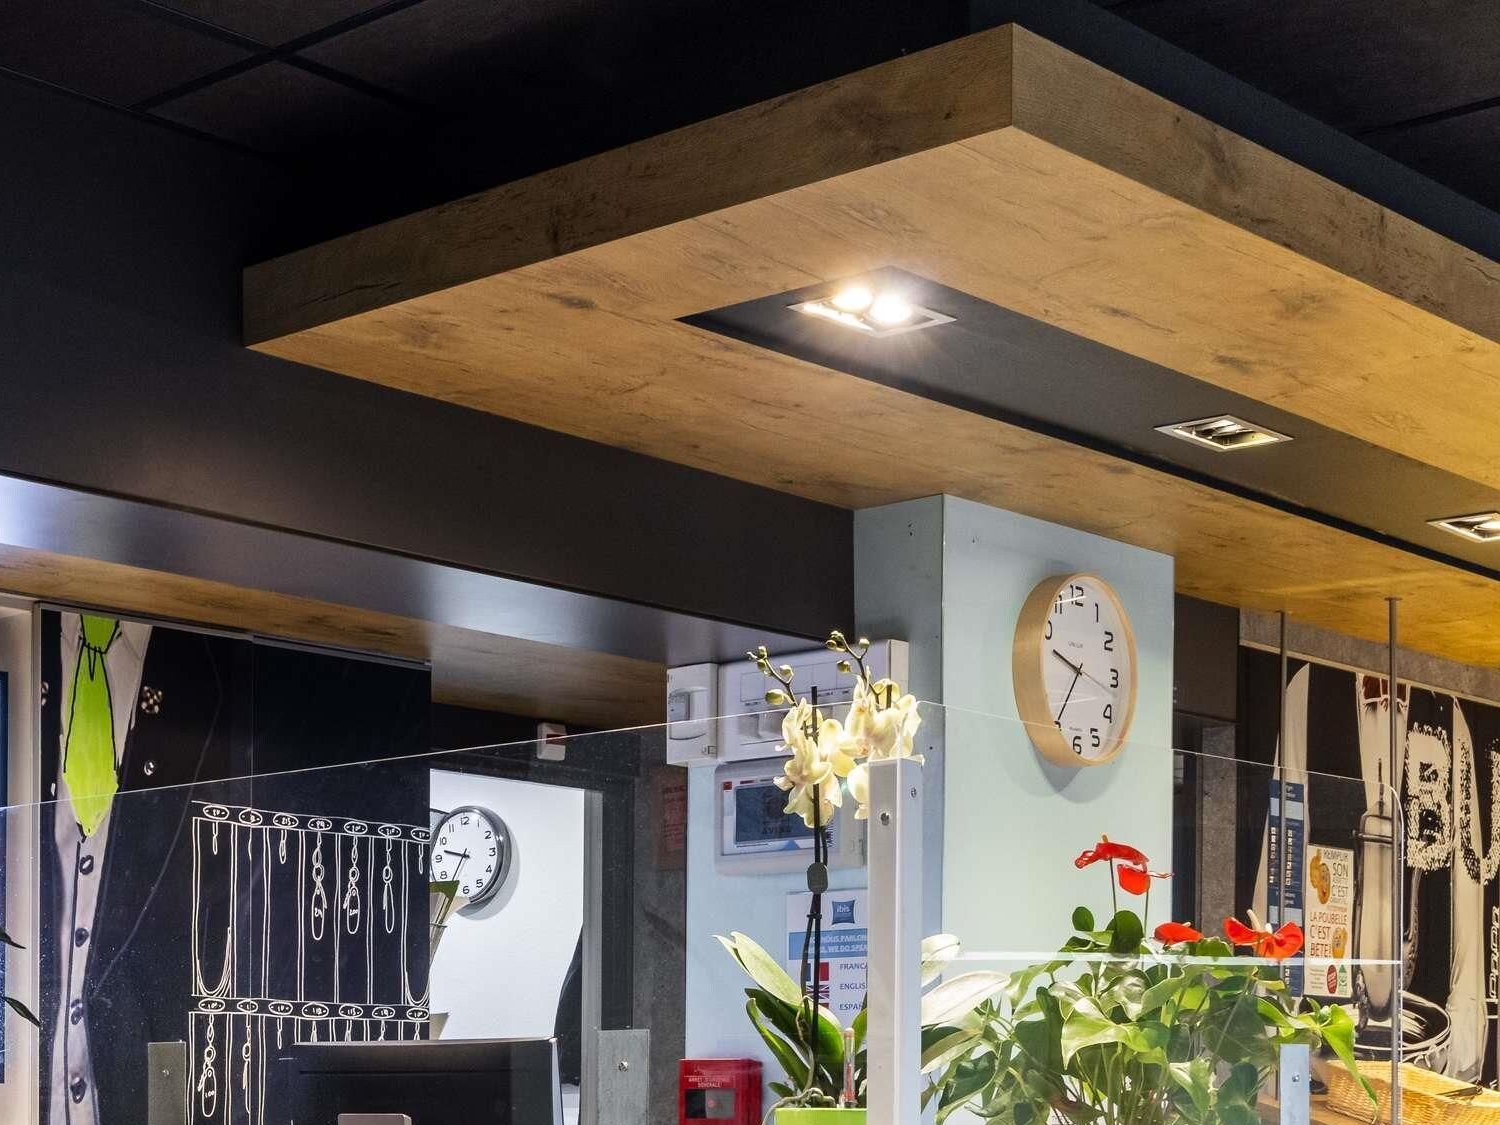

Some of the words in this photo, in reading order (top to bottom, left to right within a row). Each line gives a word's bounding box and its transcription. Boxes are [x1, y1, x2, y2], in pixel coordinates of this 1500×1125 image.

[1069, 584, 1084, 608] 12
[1103, 631, 1114, 652] 2
[1109, 668, 1120, 689] 3
[1102, 703, 1113, 724] 4
[1090, 728, 1101, 748] 5
[1072, 736, 1082, 755] 6
[460, 816, 471, 826] 12
[439, 837, 447, 847] 10
[488, 847, 496, 857] 3
[435, 854, 443, 863] 9
[439, 870, 448, 880] 8
[485, 865, 492, 874] 4
[1332, 863, 1349, 878] SON
[476, 879, 484, 888] 5
[462, 885, 470, 895] 6
[1309, 925, 1332, 940] C'EST
